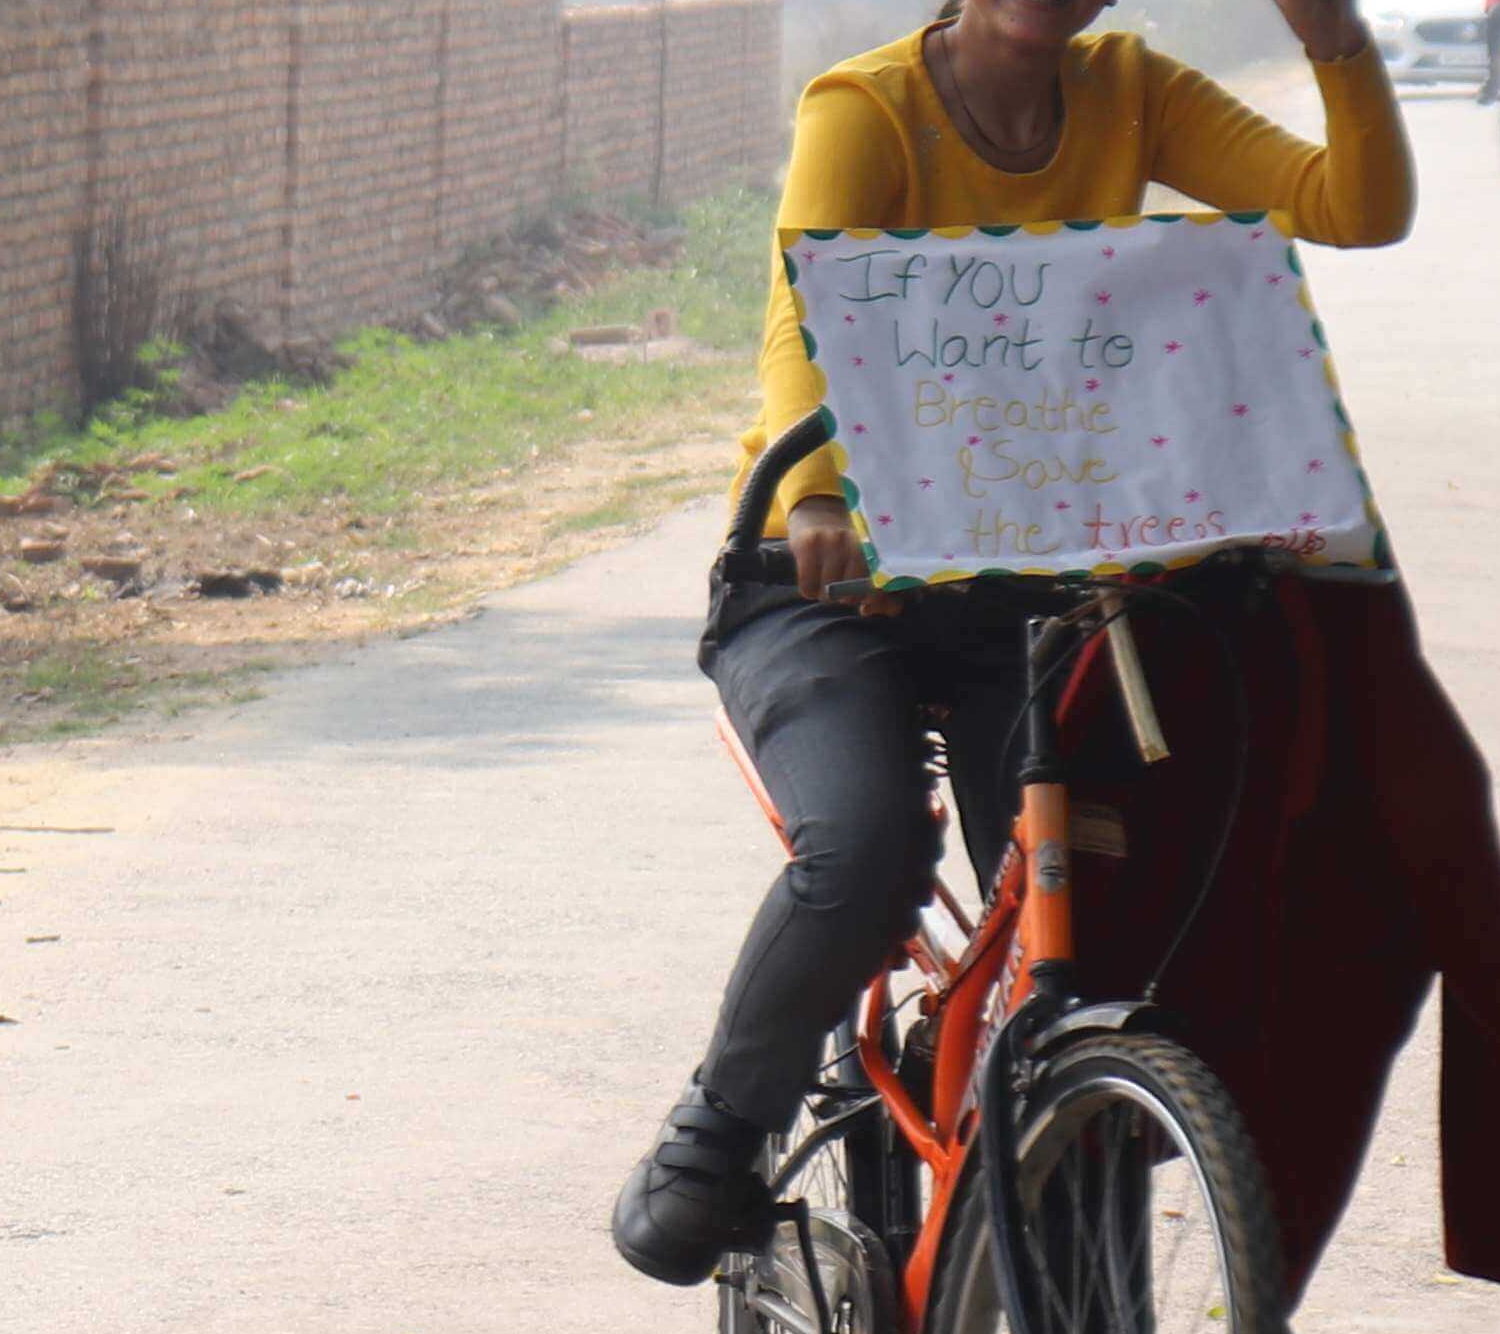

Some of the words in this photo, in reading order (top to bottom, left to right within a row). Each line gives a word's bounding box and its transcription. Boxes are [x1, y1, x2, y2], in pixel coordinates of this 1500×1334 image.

[895, 318, 1045, 370] Want
[1072, 319, 1134, 368] to
[913, 379, 1119, 435] Breathe
[966, 507, 1059, 557] the
